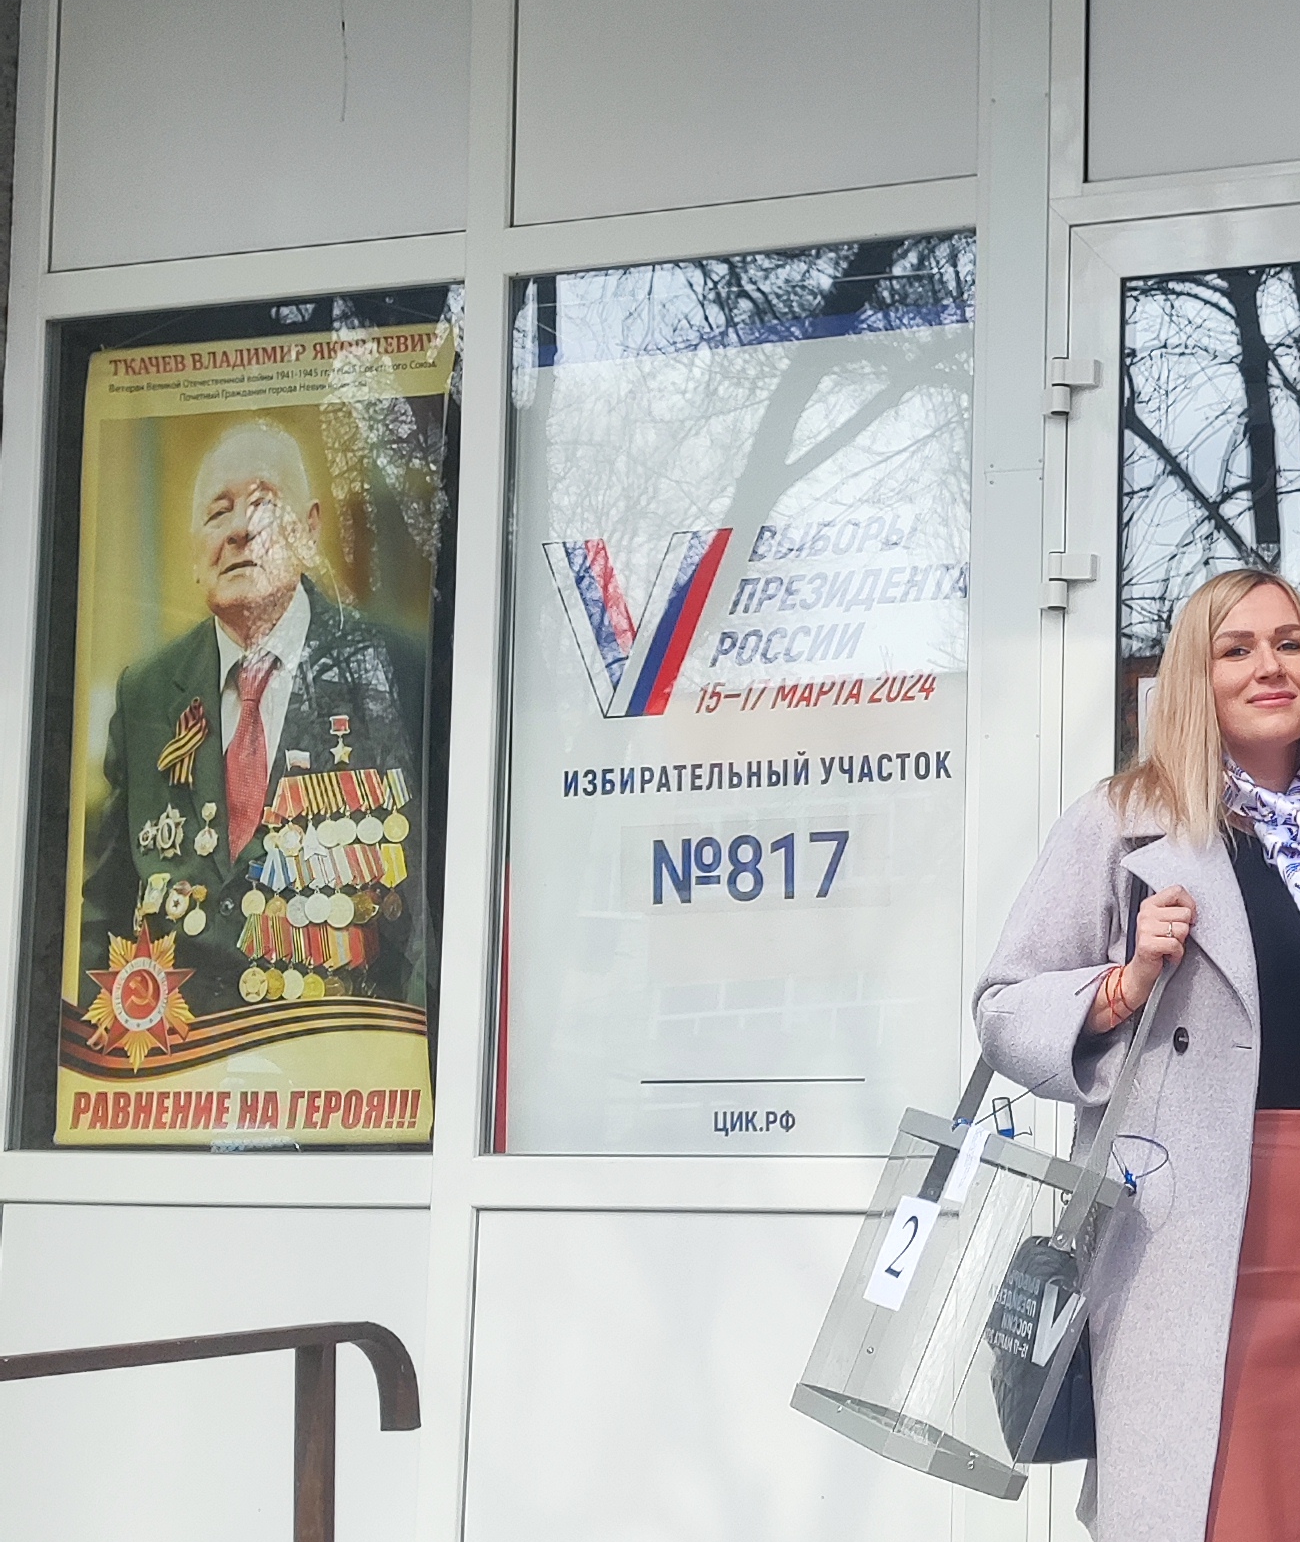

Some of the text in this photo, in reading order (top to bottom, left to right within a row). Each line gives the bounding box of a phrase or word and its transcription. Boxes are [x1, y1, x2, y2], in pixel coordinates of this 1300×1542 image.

[108, 383, 145, 394] Ветеран
[146, 380, 181, 391] Великой
[183, 374, 246, 389] Отечественной
[276, 367, 319, 380] 1941-1945
[109, 353, 187, 377] ТКАЧЕВ
[190, 343, 307, 371] ВЛАДИМИР
[179, 388, 220, 402] Почетный
[221, 385, 267, 401] Гражданин
[268, 385, 297, 398] города
[748, 513, 923, 563] ВЫБОРЫ
[728, 561, 968, 616] ПРЕЗИДЕНТА
[708, 621, 866, 668] РОССИИ
[770, 672, 864, 710] МАРТА
[867, 668, 938, 704] 2024
[563, 750, 953, 798] ИЗБИРАТЕЛЬНЫЙ УЧАСТОК
[651, 829, 850, 905] №817
[69, 1088, 422, 1131] РАВНЕНИЕ НА ГЕРОЯ!!!
[713, 1109, 797, 1136] ЦИК.РФ
[883, 1214, 920, 1279] 2
